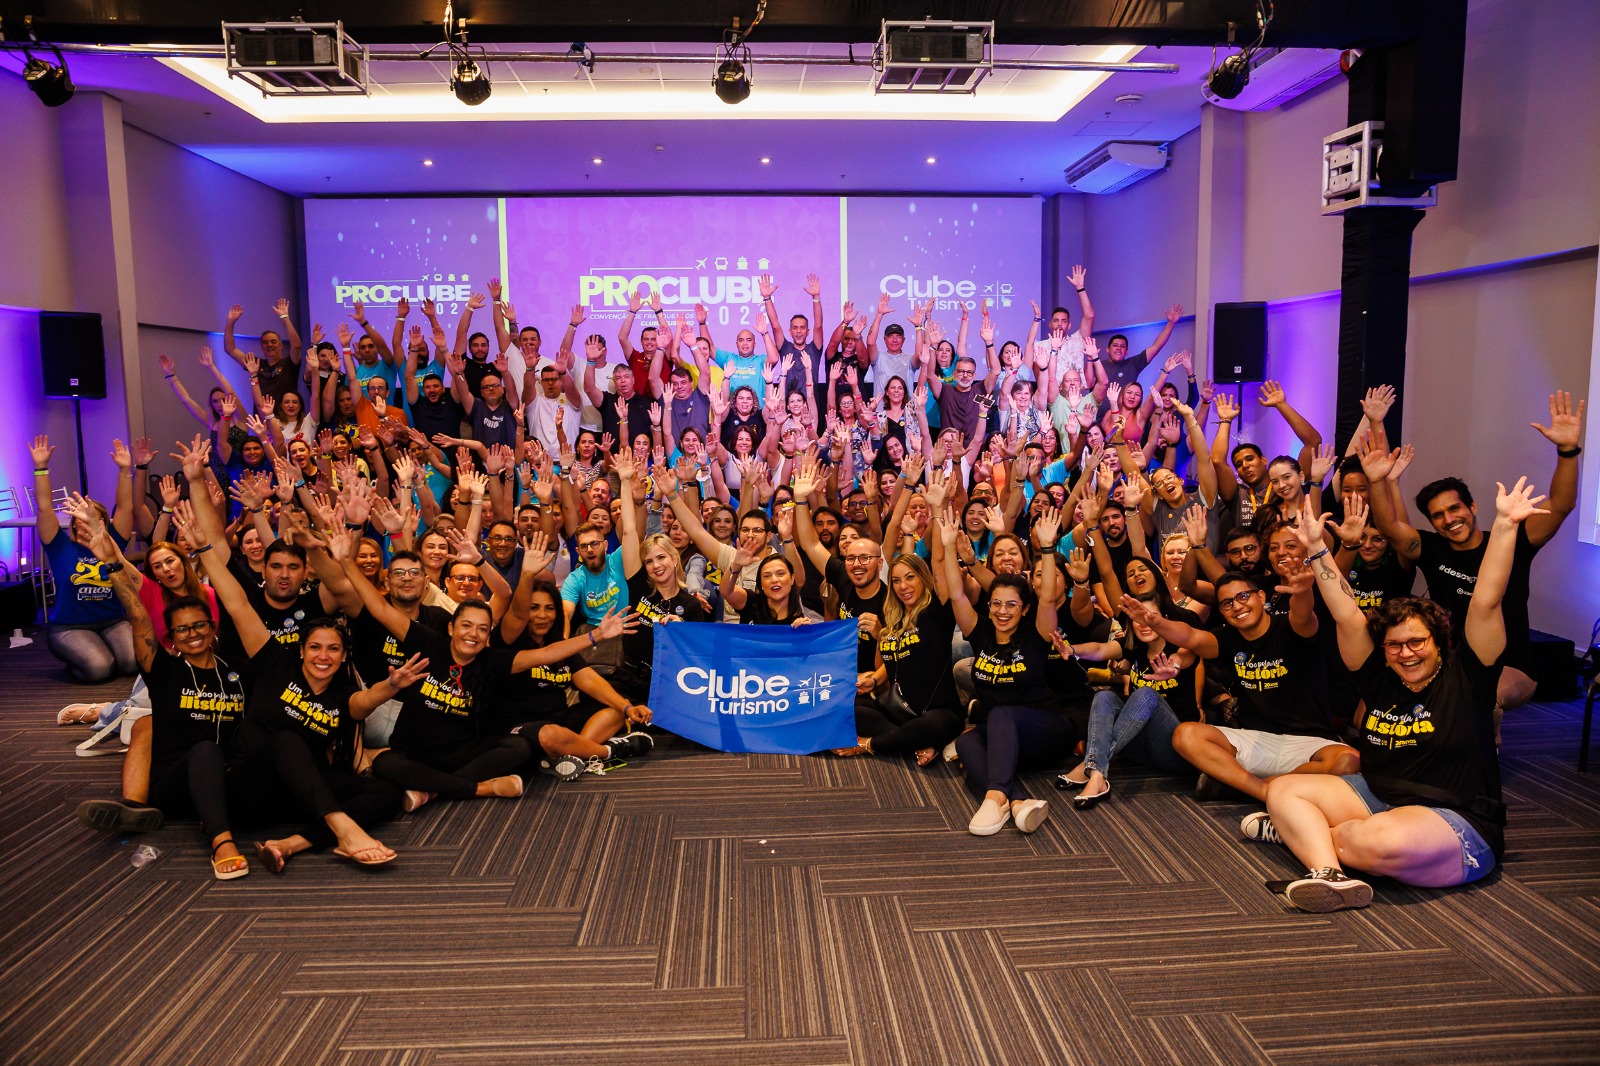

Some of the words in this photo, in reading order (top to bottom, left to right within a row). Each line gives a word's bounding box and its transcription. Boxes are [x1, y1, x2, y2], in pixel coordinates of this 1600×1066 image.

[335, 284, 472, 303] PROCLUBE
[580, 274, 774, 306] PROCLUBE
[880, 274, 976, 298] Clube
[907, 297, 976, 311] Tuismo
[590, 312, 629, 321] CONVENÇÃ
[975, 657, 1026, 675] Histria
[288, 682, 303, 694] Um
[426, 675, 438, 686] Um
[676, 666, 791, 699] Clube
[708, 697, 790, 715] Turismo
[1365, 714, 1434, 736] História
[1381, 711, 1399, 722] voo
